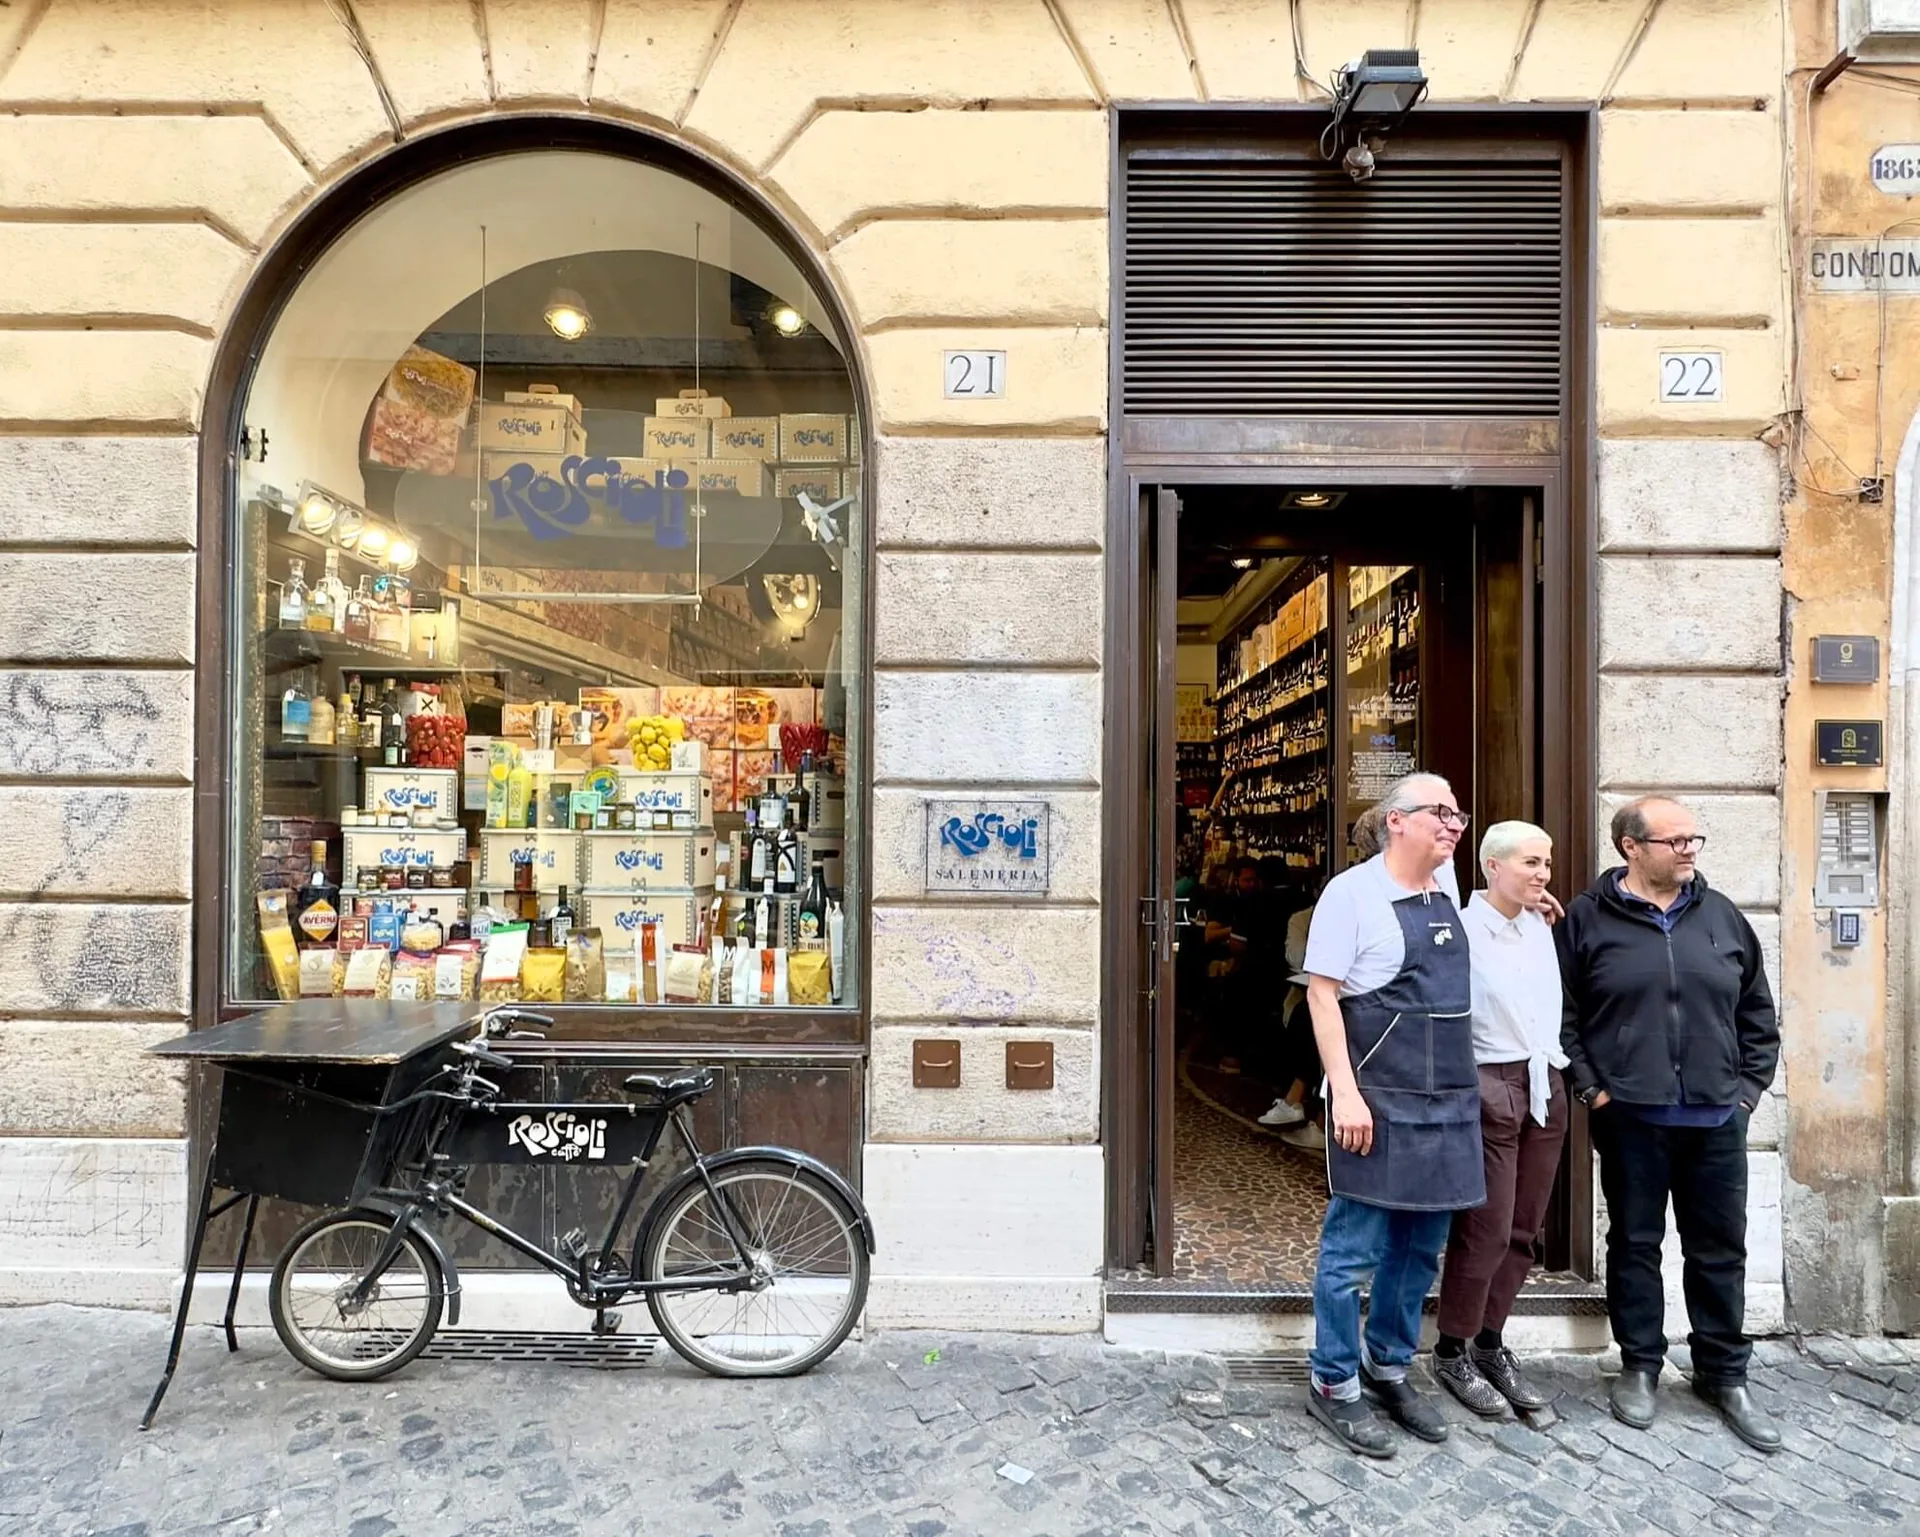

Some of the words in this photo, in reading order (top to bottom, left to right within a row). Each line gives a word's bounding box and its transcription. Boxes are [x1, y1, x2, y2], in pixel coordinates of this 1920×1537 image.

[950, 354, 996, 394] 21
[1665, 357, 1718, 396] 22
[935, 869, 1039, 880] SALUMERIA
